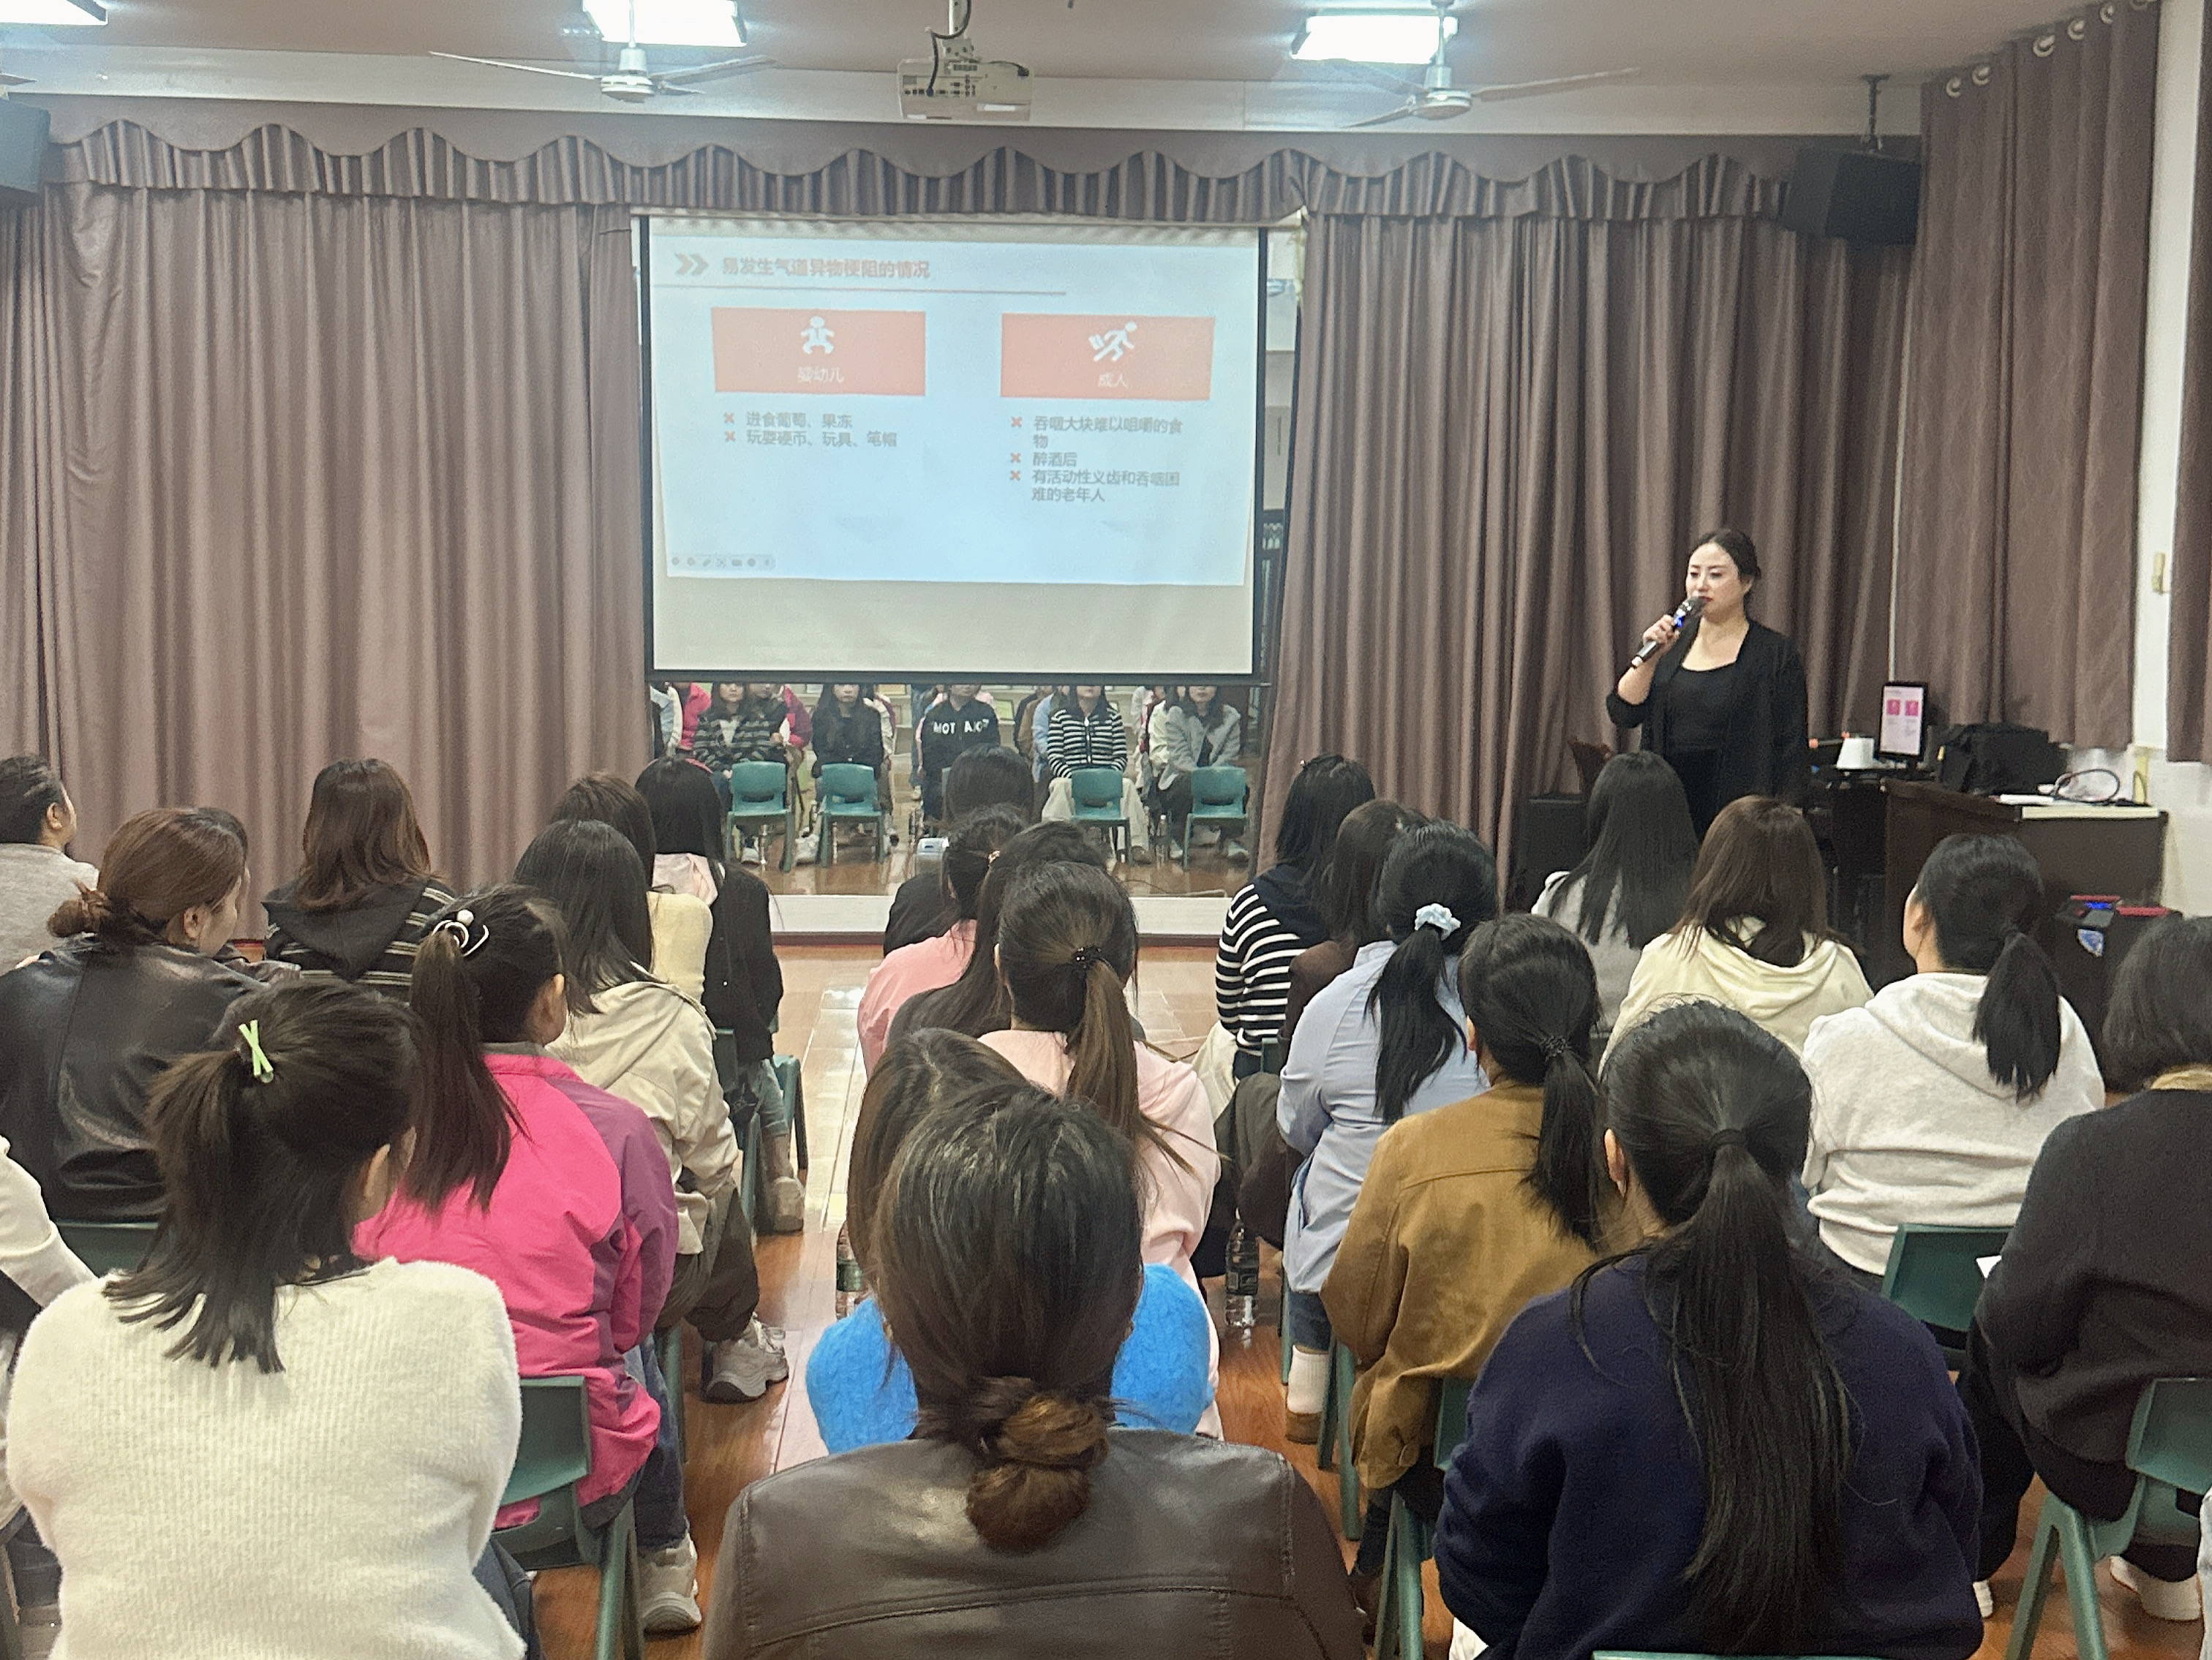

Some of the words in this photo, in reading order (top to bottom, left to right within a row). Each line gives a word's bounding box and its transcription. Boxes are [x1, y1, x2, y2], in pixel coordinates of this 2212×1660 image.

[797, 366, 844, 383] 婴幼儿
[1099, 372, 1129, 389] 成人
[1033, 434, 1048, 449] 物
[1032, 452, 1077, 467] 醉酒后
[1032, 469, 1181, 487] 有活动性义齿和吞咽困
[1031, 488, 1105, 502] 难的老年人
